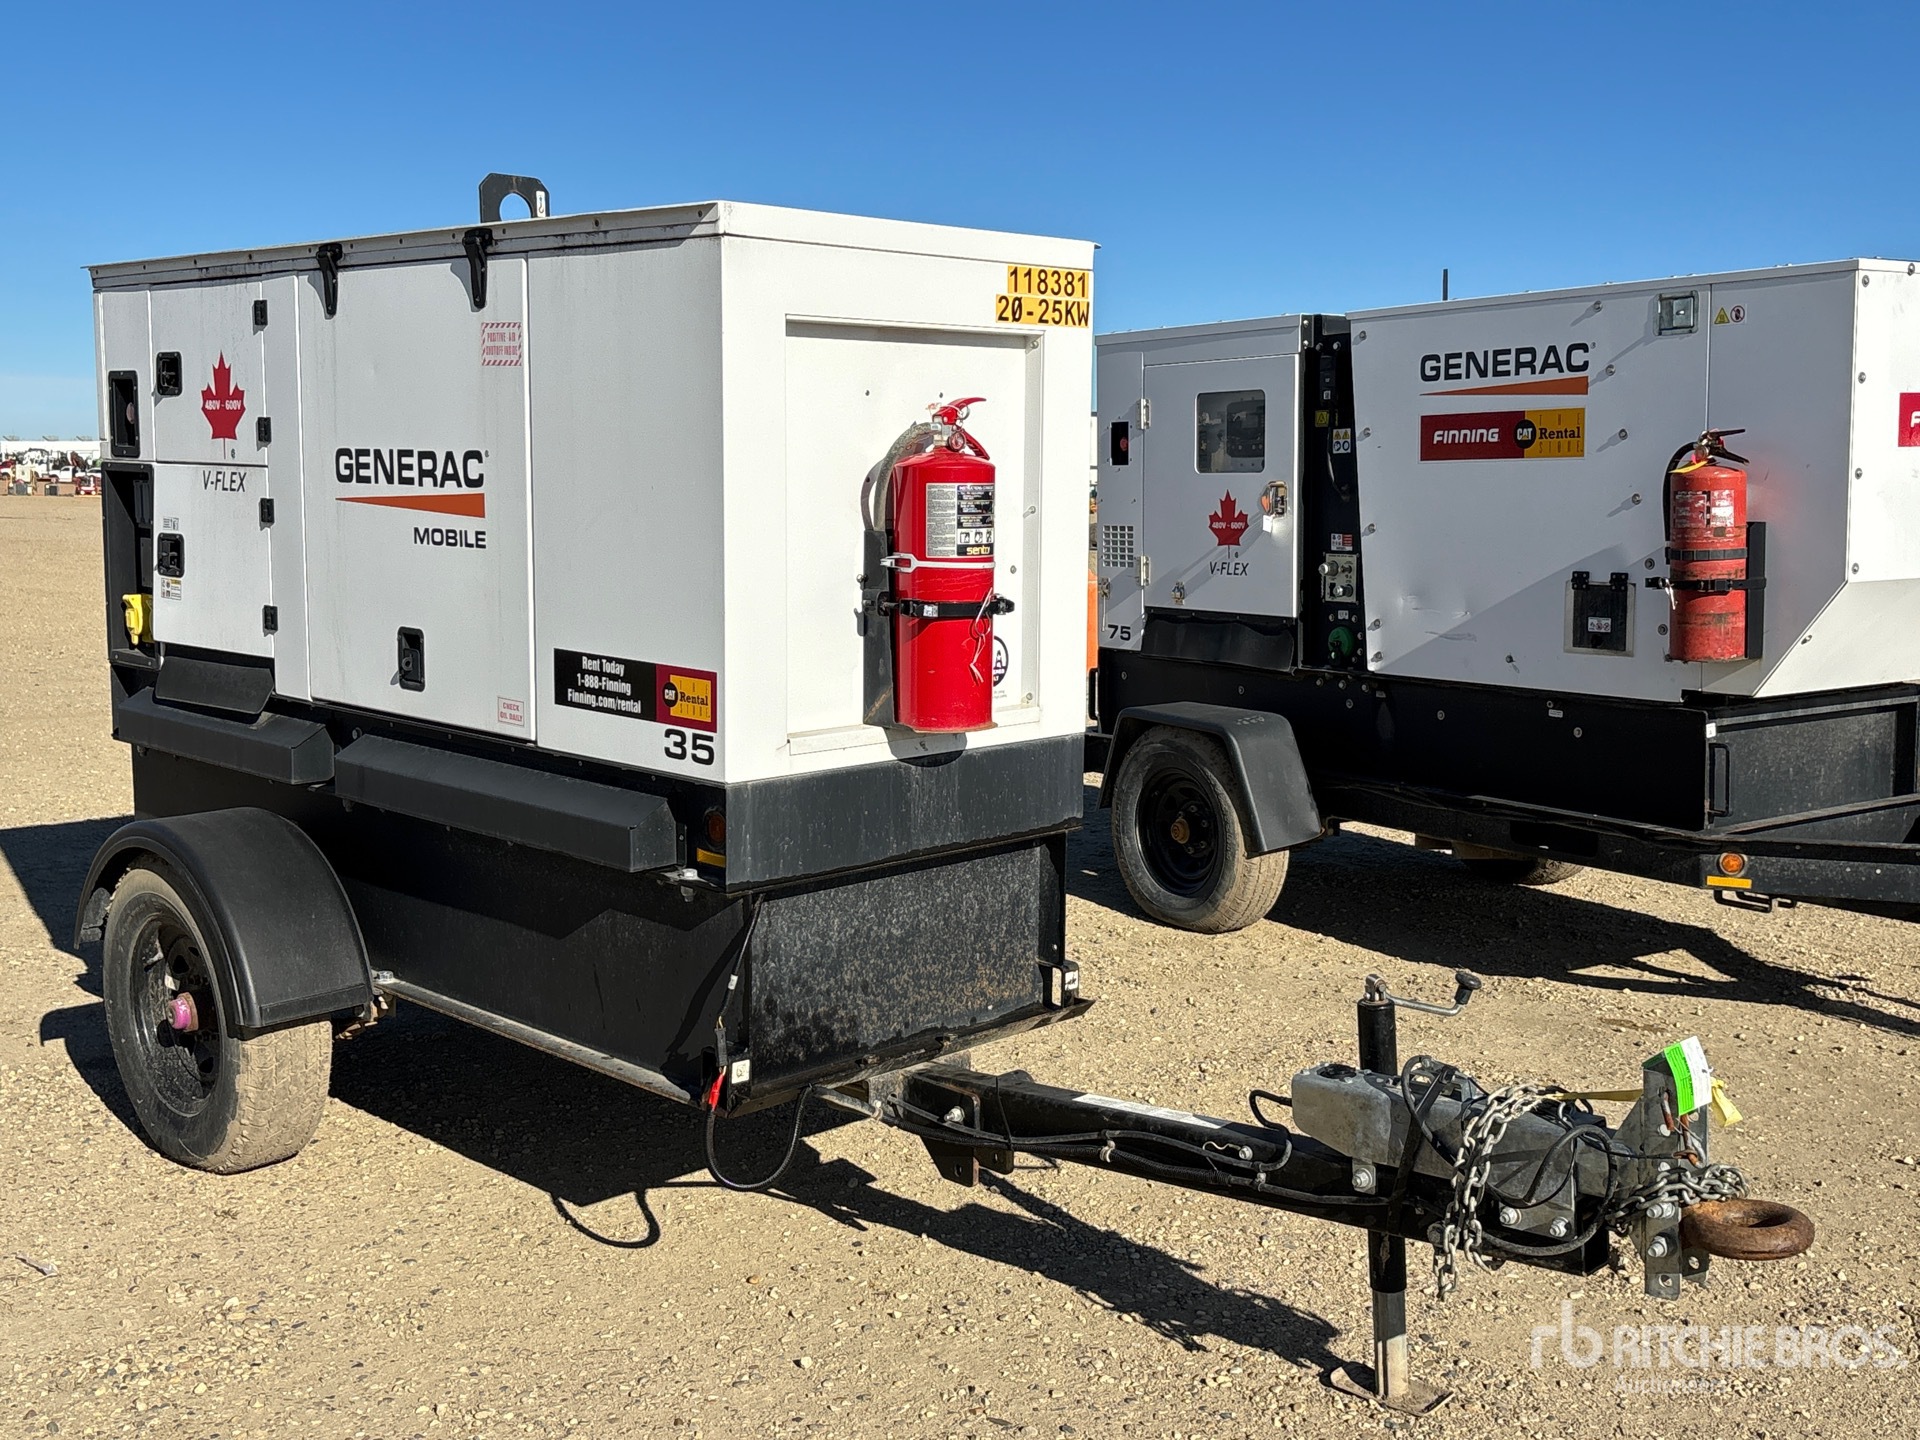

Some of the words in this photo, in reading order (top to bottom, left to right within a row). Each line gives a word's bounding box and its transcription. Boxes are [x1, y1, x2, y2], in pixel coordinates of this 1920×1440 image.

[1009, 266, 1086, 297] 118381
[1420, 342, 1589, 382] GENERAC
[205, 399, 220, 410] 480V
[225, 399, 242, 410] 600V
[1433, 428, 1500, 445] FINNING
[1516, 427, 1533, 441] CAT
[1538, 426, 1582, 440] Rental
[335, 447, 485, 489] GENERAC
[202, 469, 248, 493] V-FLEX
[413, 526, 487, 550] MOBILE
[1209, 561, 1250, 577] V-FLEX
[1107, 623, 1132, 642] 75
[582, 655, 601, 672] Rent
[601, 658, 625, 677] Today
[576, 673, 632, 697] 1-888-Finning
[502, 701, 520, 712] CHECK
[567, 688, 642, 714] Finning.com/rental
[664, 688, 676, 701] CAT
[679, 691, 709, 707] Rental
[663, 728, 715, 766] 35
